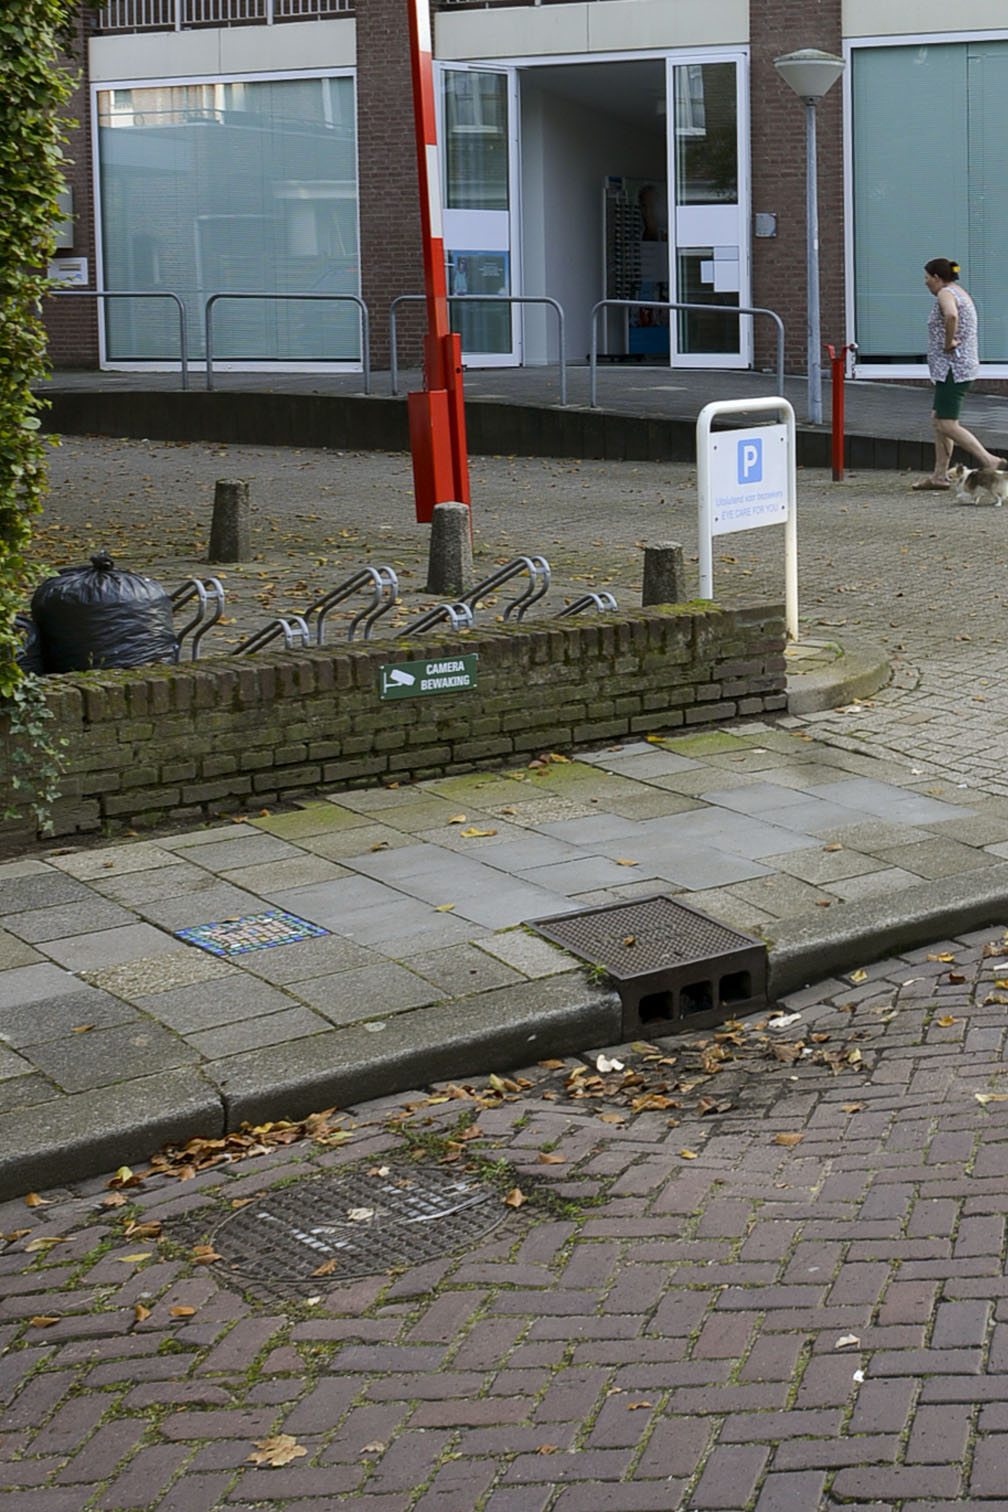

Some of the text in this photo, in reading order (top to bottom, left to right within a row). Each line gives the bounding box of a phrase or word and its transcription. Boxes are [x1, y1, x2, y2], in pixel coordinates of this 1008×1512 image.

[743, 444, 758, 478] P
[721, 503, 778, 521] EYE CARE FOR YOU
[426, 660, 465, 675] CAMERA
[420, 675, 470, 690] BEWAKING
